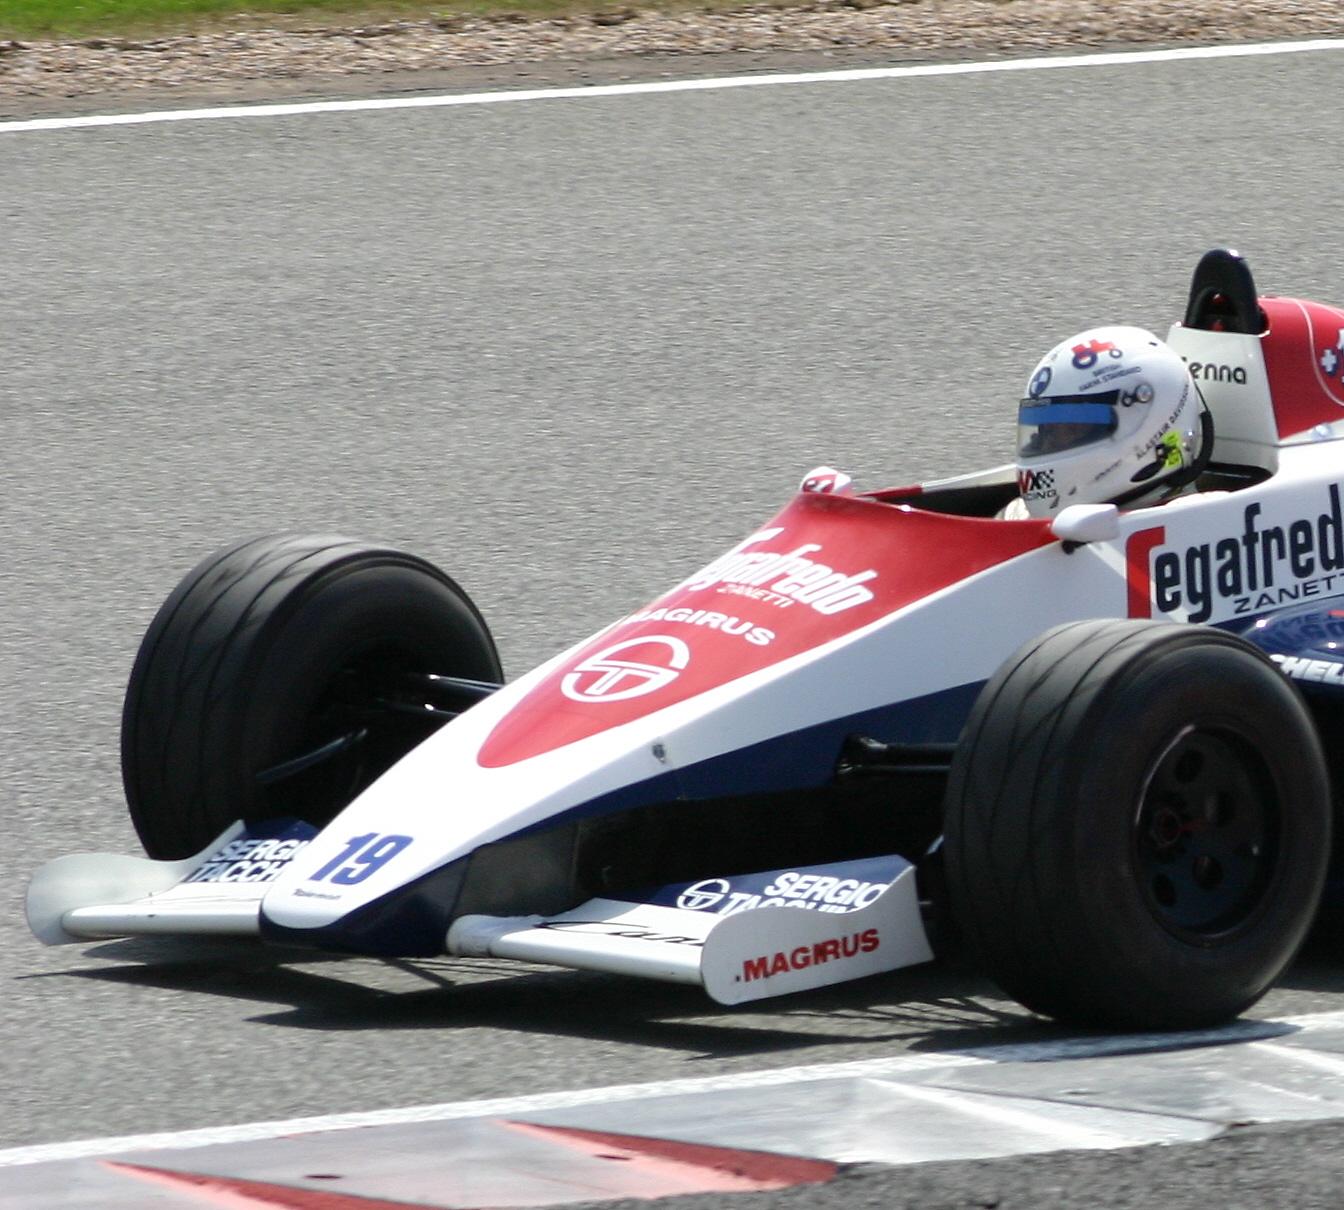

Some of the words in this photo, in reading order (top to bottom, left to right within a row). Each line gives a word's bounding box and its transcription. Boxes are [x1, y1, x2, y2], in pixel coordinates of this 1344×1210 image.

[1182, 356, 1247, 385] enna
[716, 582, 796, 608] ZANETTI
[211, 838, 311, 861] SERGI
[308, 832, 414, 886] 19
[763, 871, 889, 907] SERGIO
[743, 928, 880, 982] MAGIRUS
